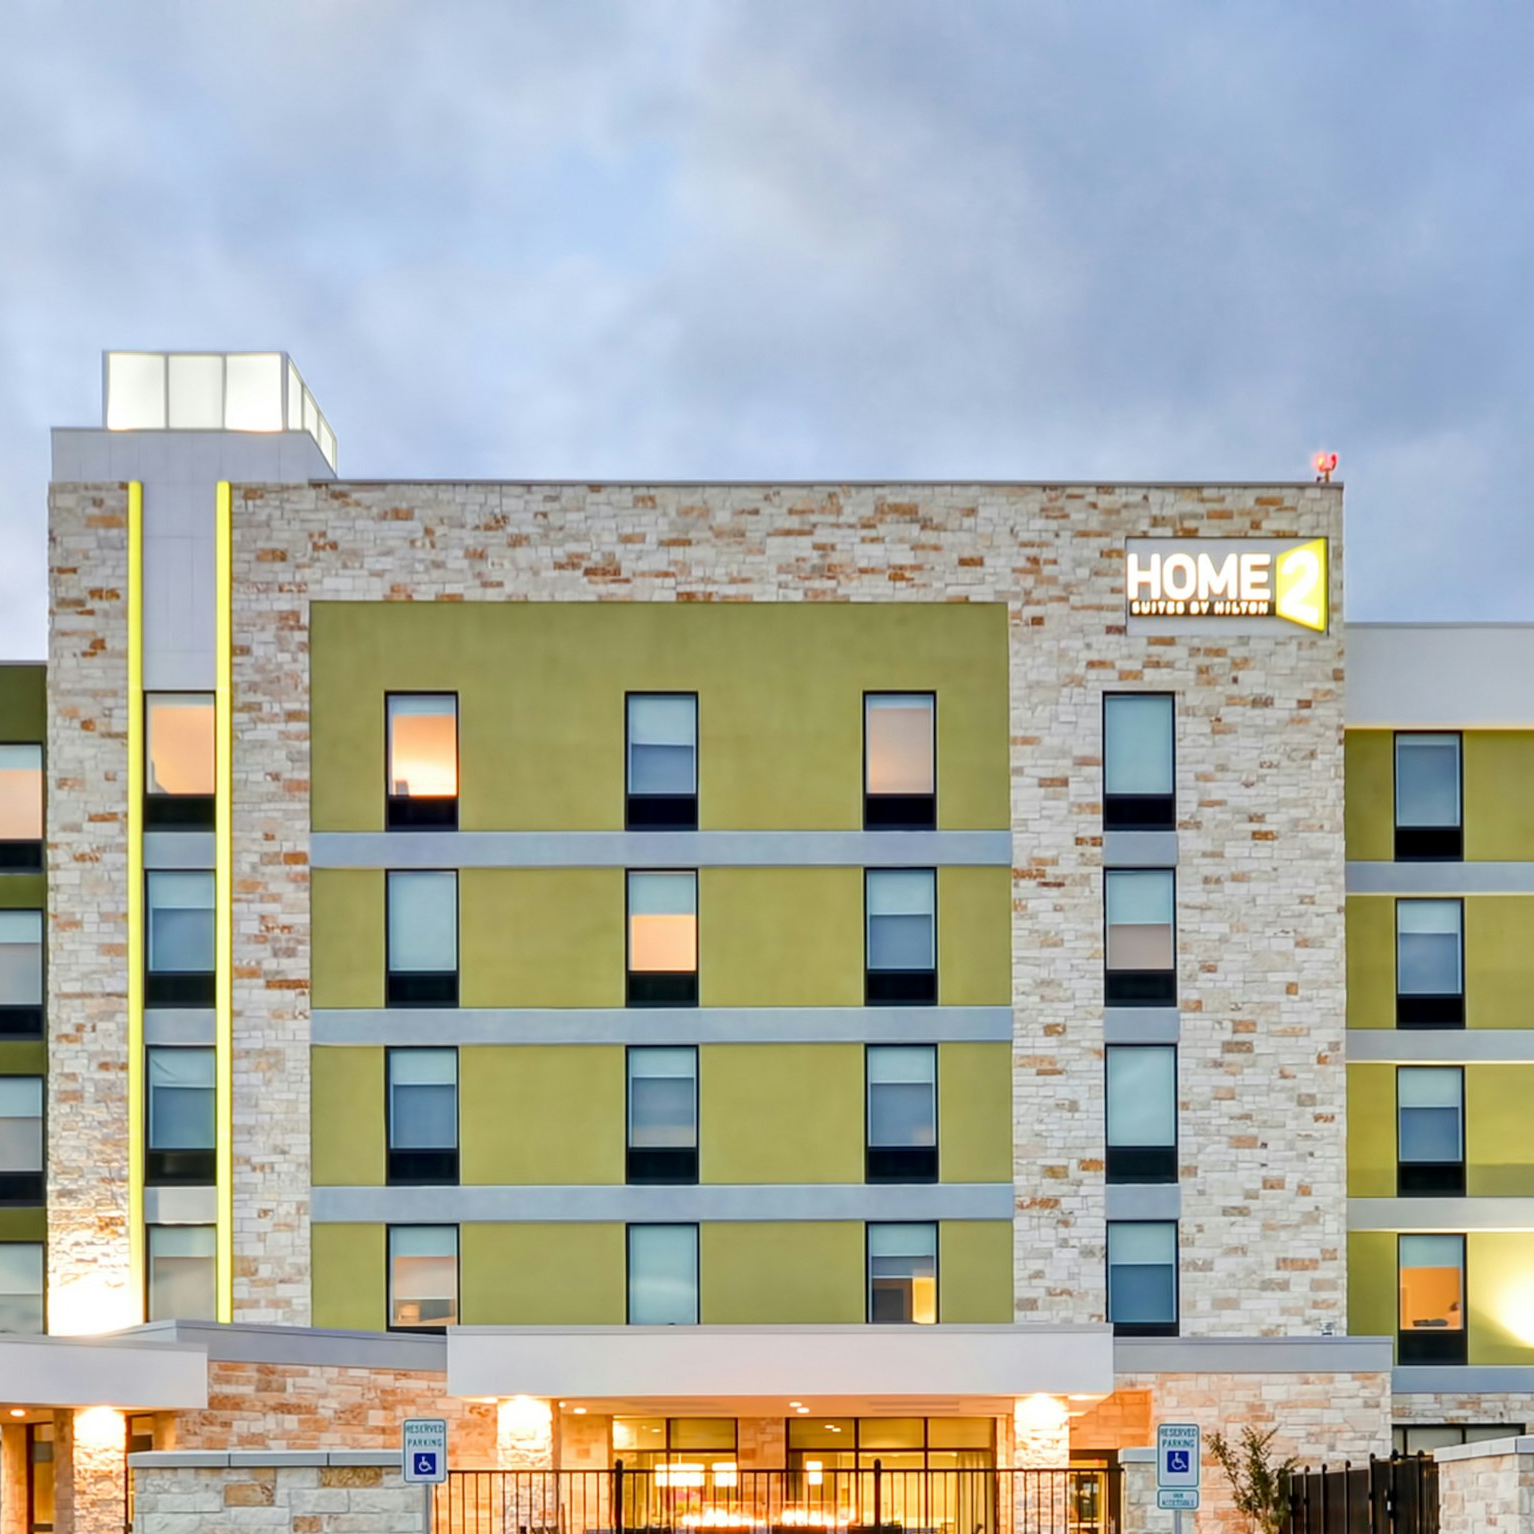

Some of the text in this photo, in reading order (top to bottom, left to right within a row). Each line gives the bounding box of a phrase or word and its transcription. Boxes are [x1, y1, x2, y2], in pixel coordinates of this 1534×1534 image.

[1127, 549, 1319, 624] HOME 2
[1131, 600, 1269, 615] SUITES BY HILTON
[406, 1424, 444, 1434] RESERVED
[1160, 1428, 1197, 1437] RESERVED
[407, 1438, 443, 1447] PARKING
[1162, 1439, 1195, 1448] PARKING
